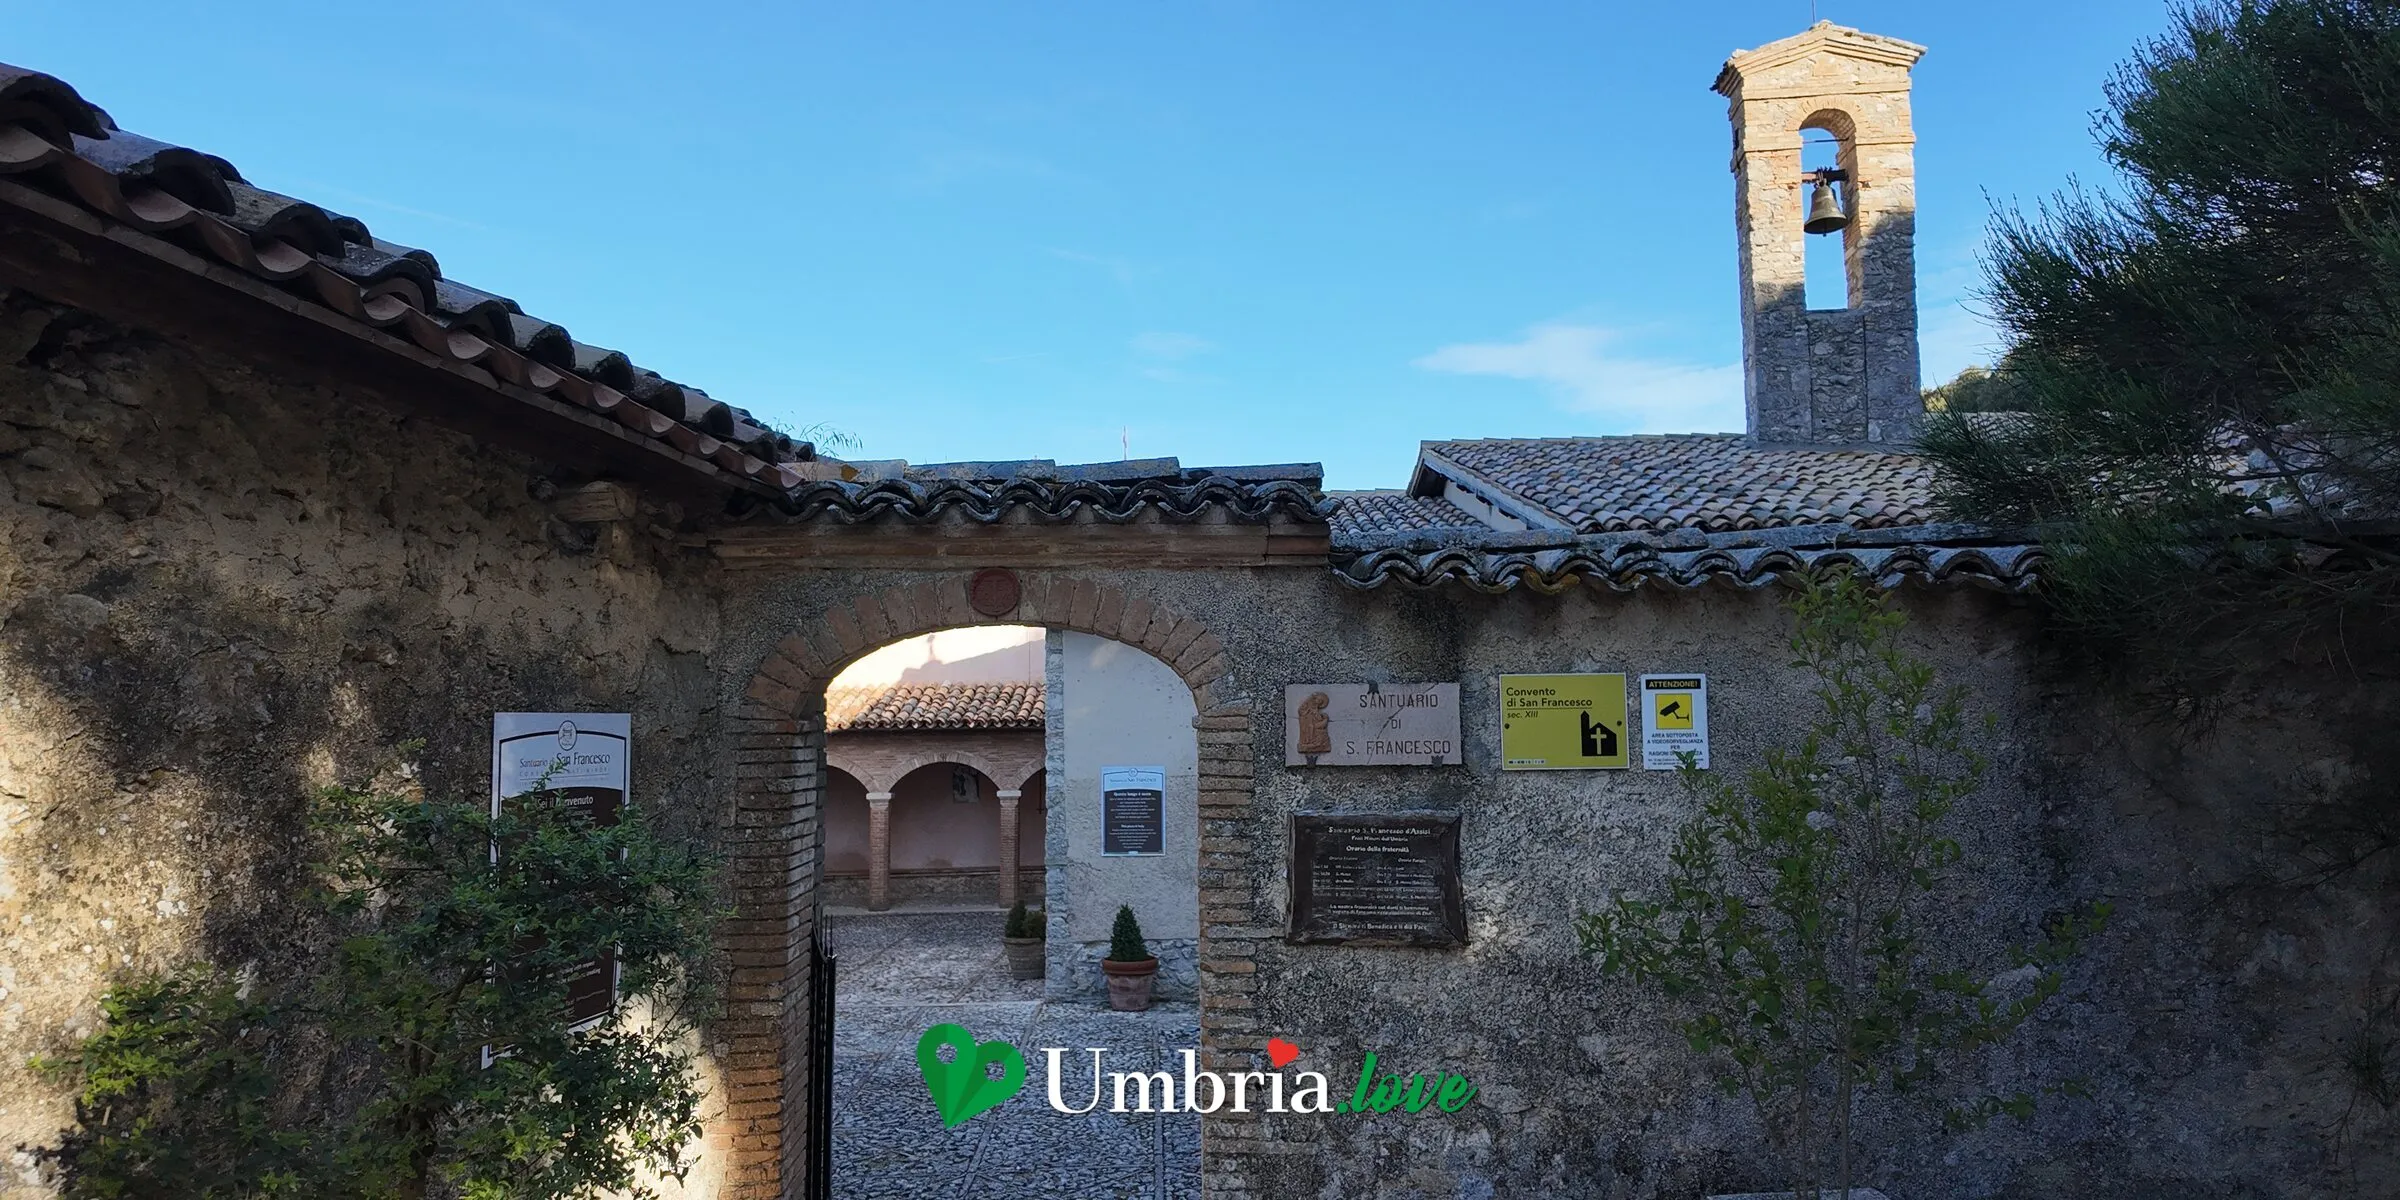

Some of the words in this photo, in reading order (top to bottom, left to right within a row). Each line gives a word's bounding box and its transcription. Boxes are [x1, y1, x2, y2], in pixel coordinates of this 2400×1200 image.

[1648, 680, 1698, 688] ATTENZIONE!
[1506, 687, 1556, 696] Convento
[1359, 693, 1440, 708] SANTUARIO
[1506, 698, 1517, 708] di
[1519, 698, 1538, 707] San
[1541, 697, 1593, 707] Francesco
[1507, 711, 1523, 719] sec.
[1525, 710, 1539, 718] XIII
[1391, 719, 1402, 730] DI
[1346, 740, 1360, 755] S.
[1366, 740, 1451, 754] FRANCESCO
[519, 757, 548, 769] Santuario
[556, 752, 571, 766] San
[573, 751, 611, 765] Francesco
[555, 795, 594, 808] Bnvenuto
